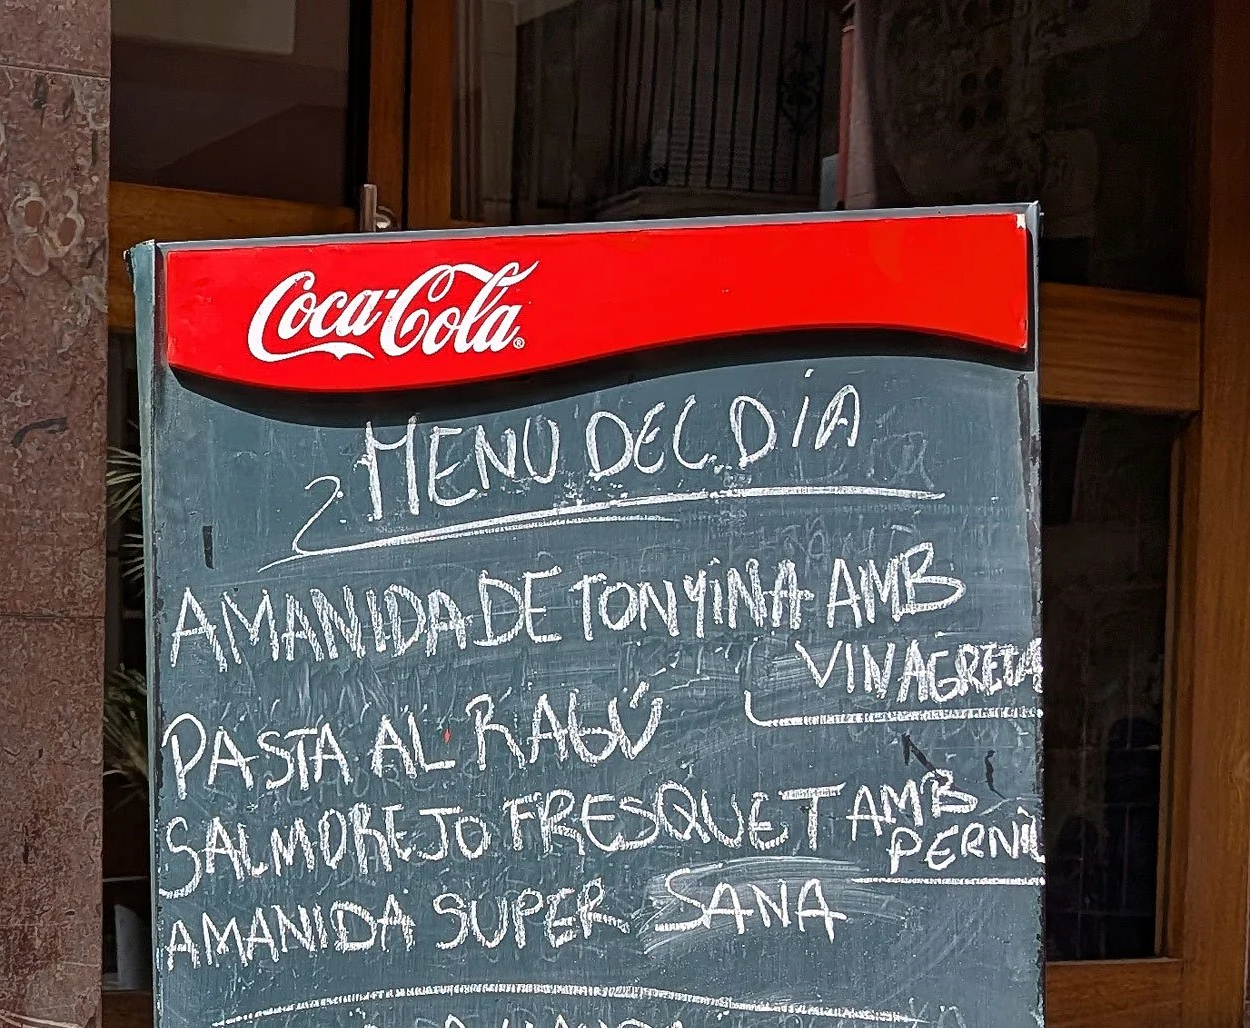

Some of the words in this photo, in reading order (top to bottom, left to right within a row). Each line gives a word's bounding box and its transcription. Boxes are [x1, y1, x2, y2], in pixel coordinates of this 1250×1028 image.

[247, 260, 540, 362] Coca-Cola
[170, 584, 470, 672] AMANIDA
[473, 566, 563, 646] DE
[826, 542, 966, 628] AMB
[795, 637, 1044, 703] VINAGRETA
[161, 713, 353, 800] PASTA
[371, 712, 455, 779] AL
[159, 802, 492, 898] SALMOREJO
[504, 779, 846, 857] FRESQUET
[846, 768, 978, 842] AMB
[165, 894, 416, 970] AMANIDA
[432, 876, 631, 951] SUPER
[655, 868, 848, 942] SANA
